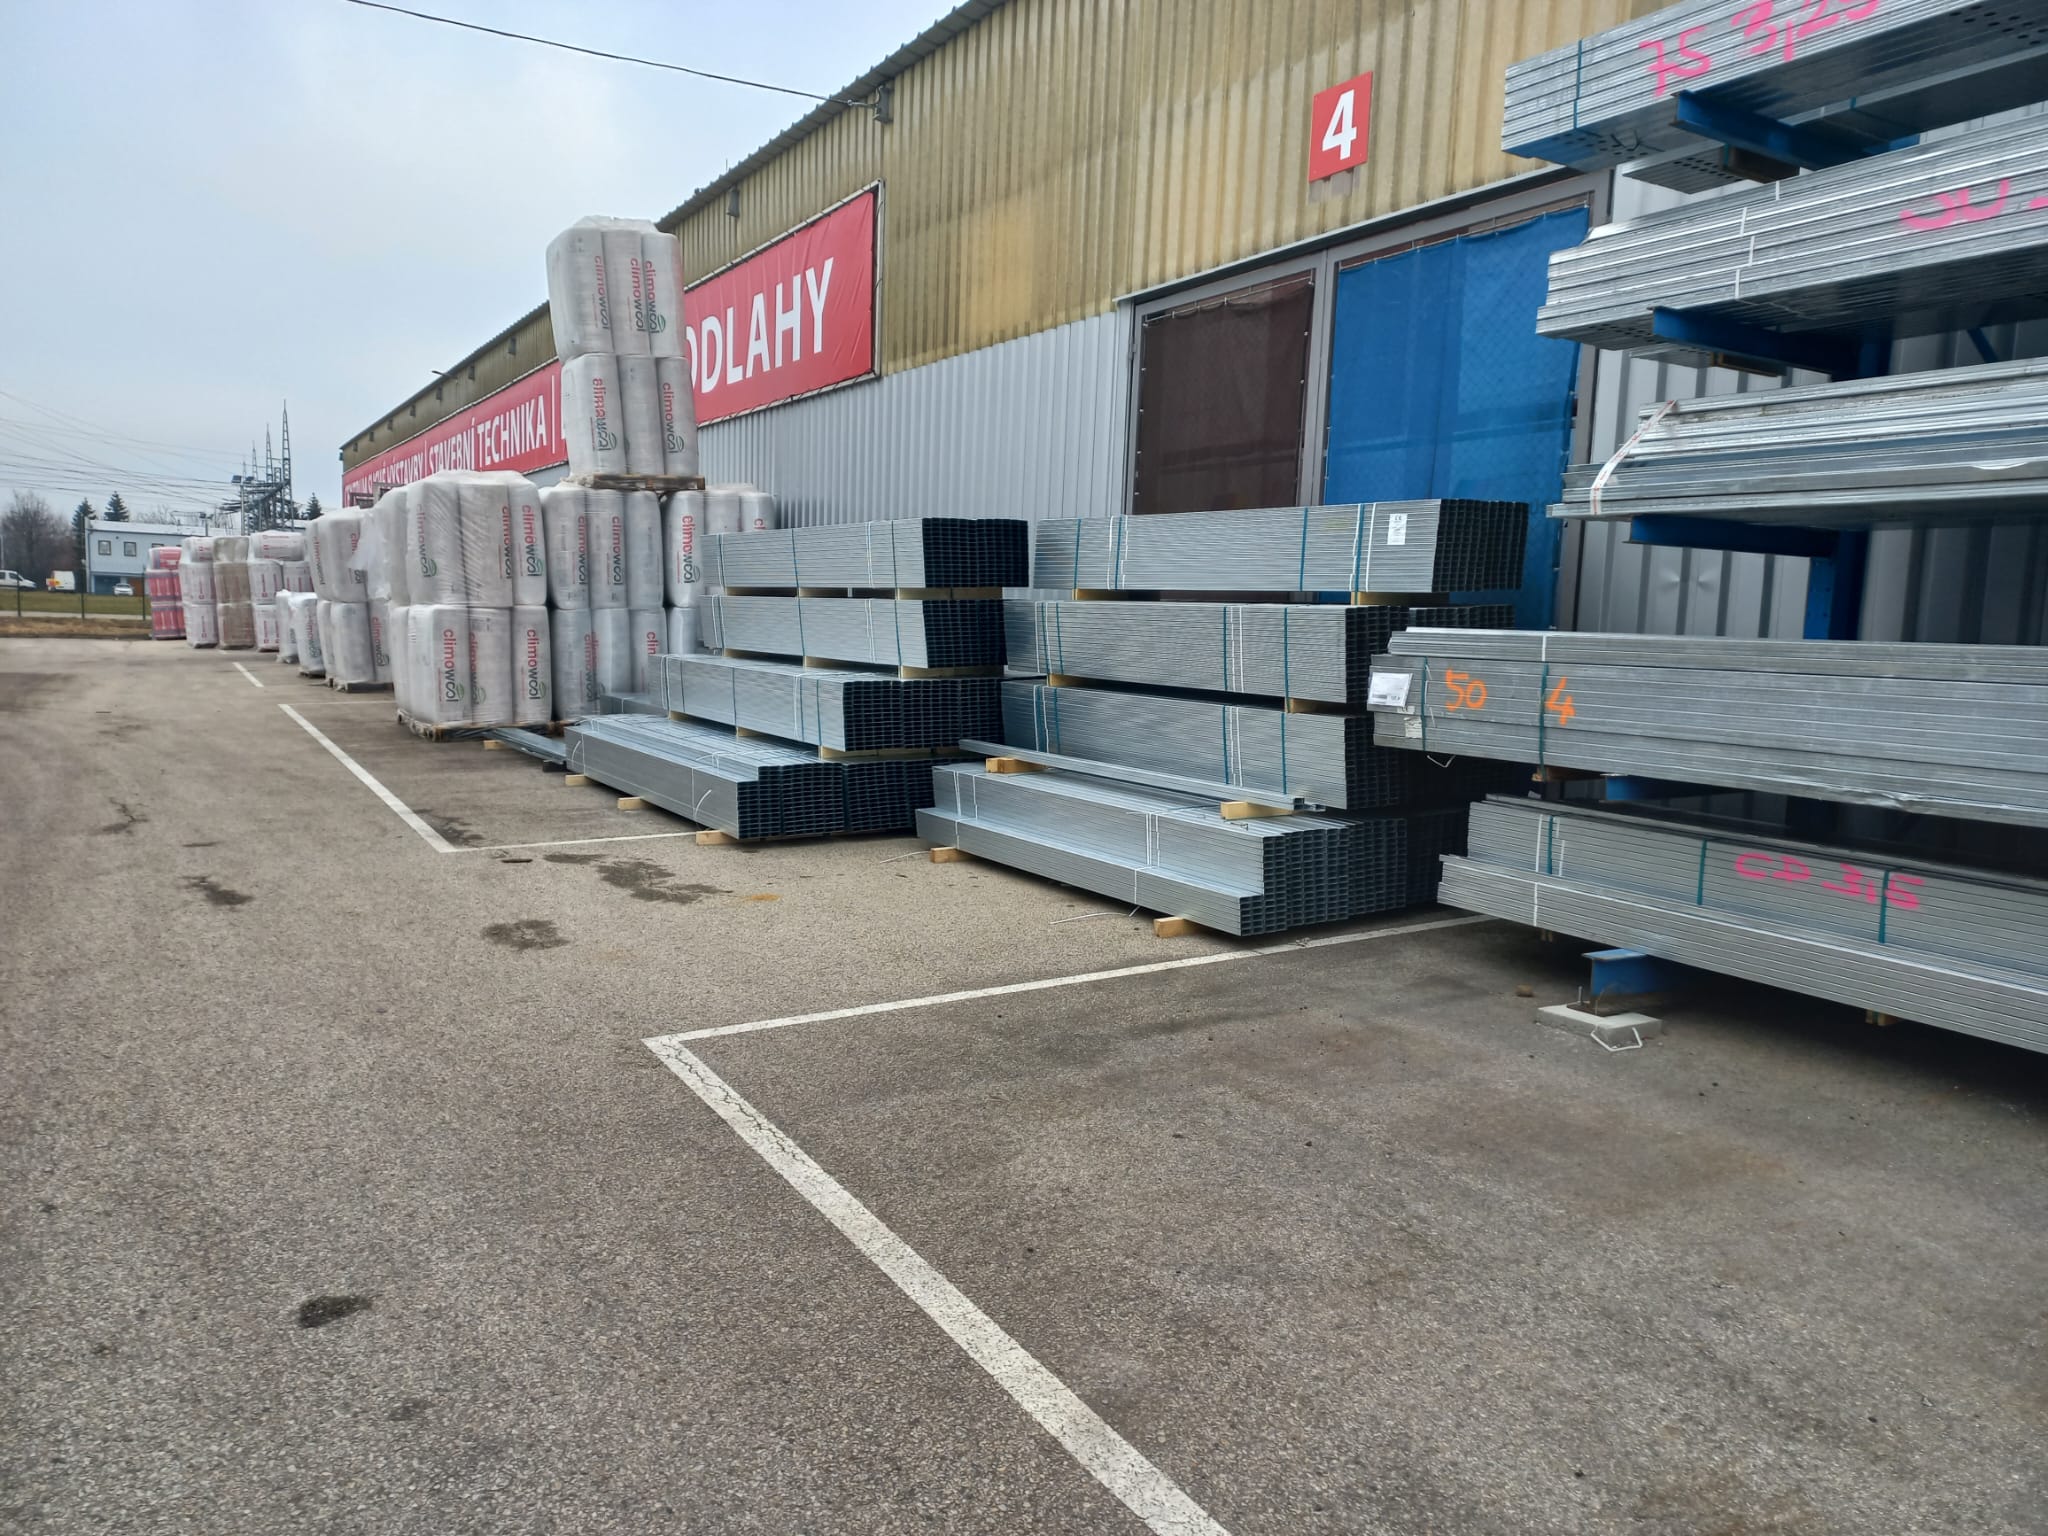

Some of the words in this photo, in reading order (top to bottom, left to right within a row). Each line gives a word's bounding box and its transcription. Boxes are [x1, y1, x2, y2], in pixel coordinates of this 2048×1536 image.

[1321, 89, 1357, 160] 4
[630, 258, 646, 332] climowool
[645, 260, 660, 334] climowool
[429, 417, 475, 477] STAVEBNÍ
[477, 395, 548, 468] TECHNIKA
[592, 378, 612, 452] climowool
[662, 382, 678, 454] climowool
[522, 505, 542, 577] climowool
[612, 516, 623, 585] climowool
[682, 515, 695, 584] climowool
[444, 629, 459, 702] climowool
[527, 629, 540, 699] climowool
[1445, 668, 1488, 712] 50
[1545, 676, 1576, 726] 4
